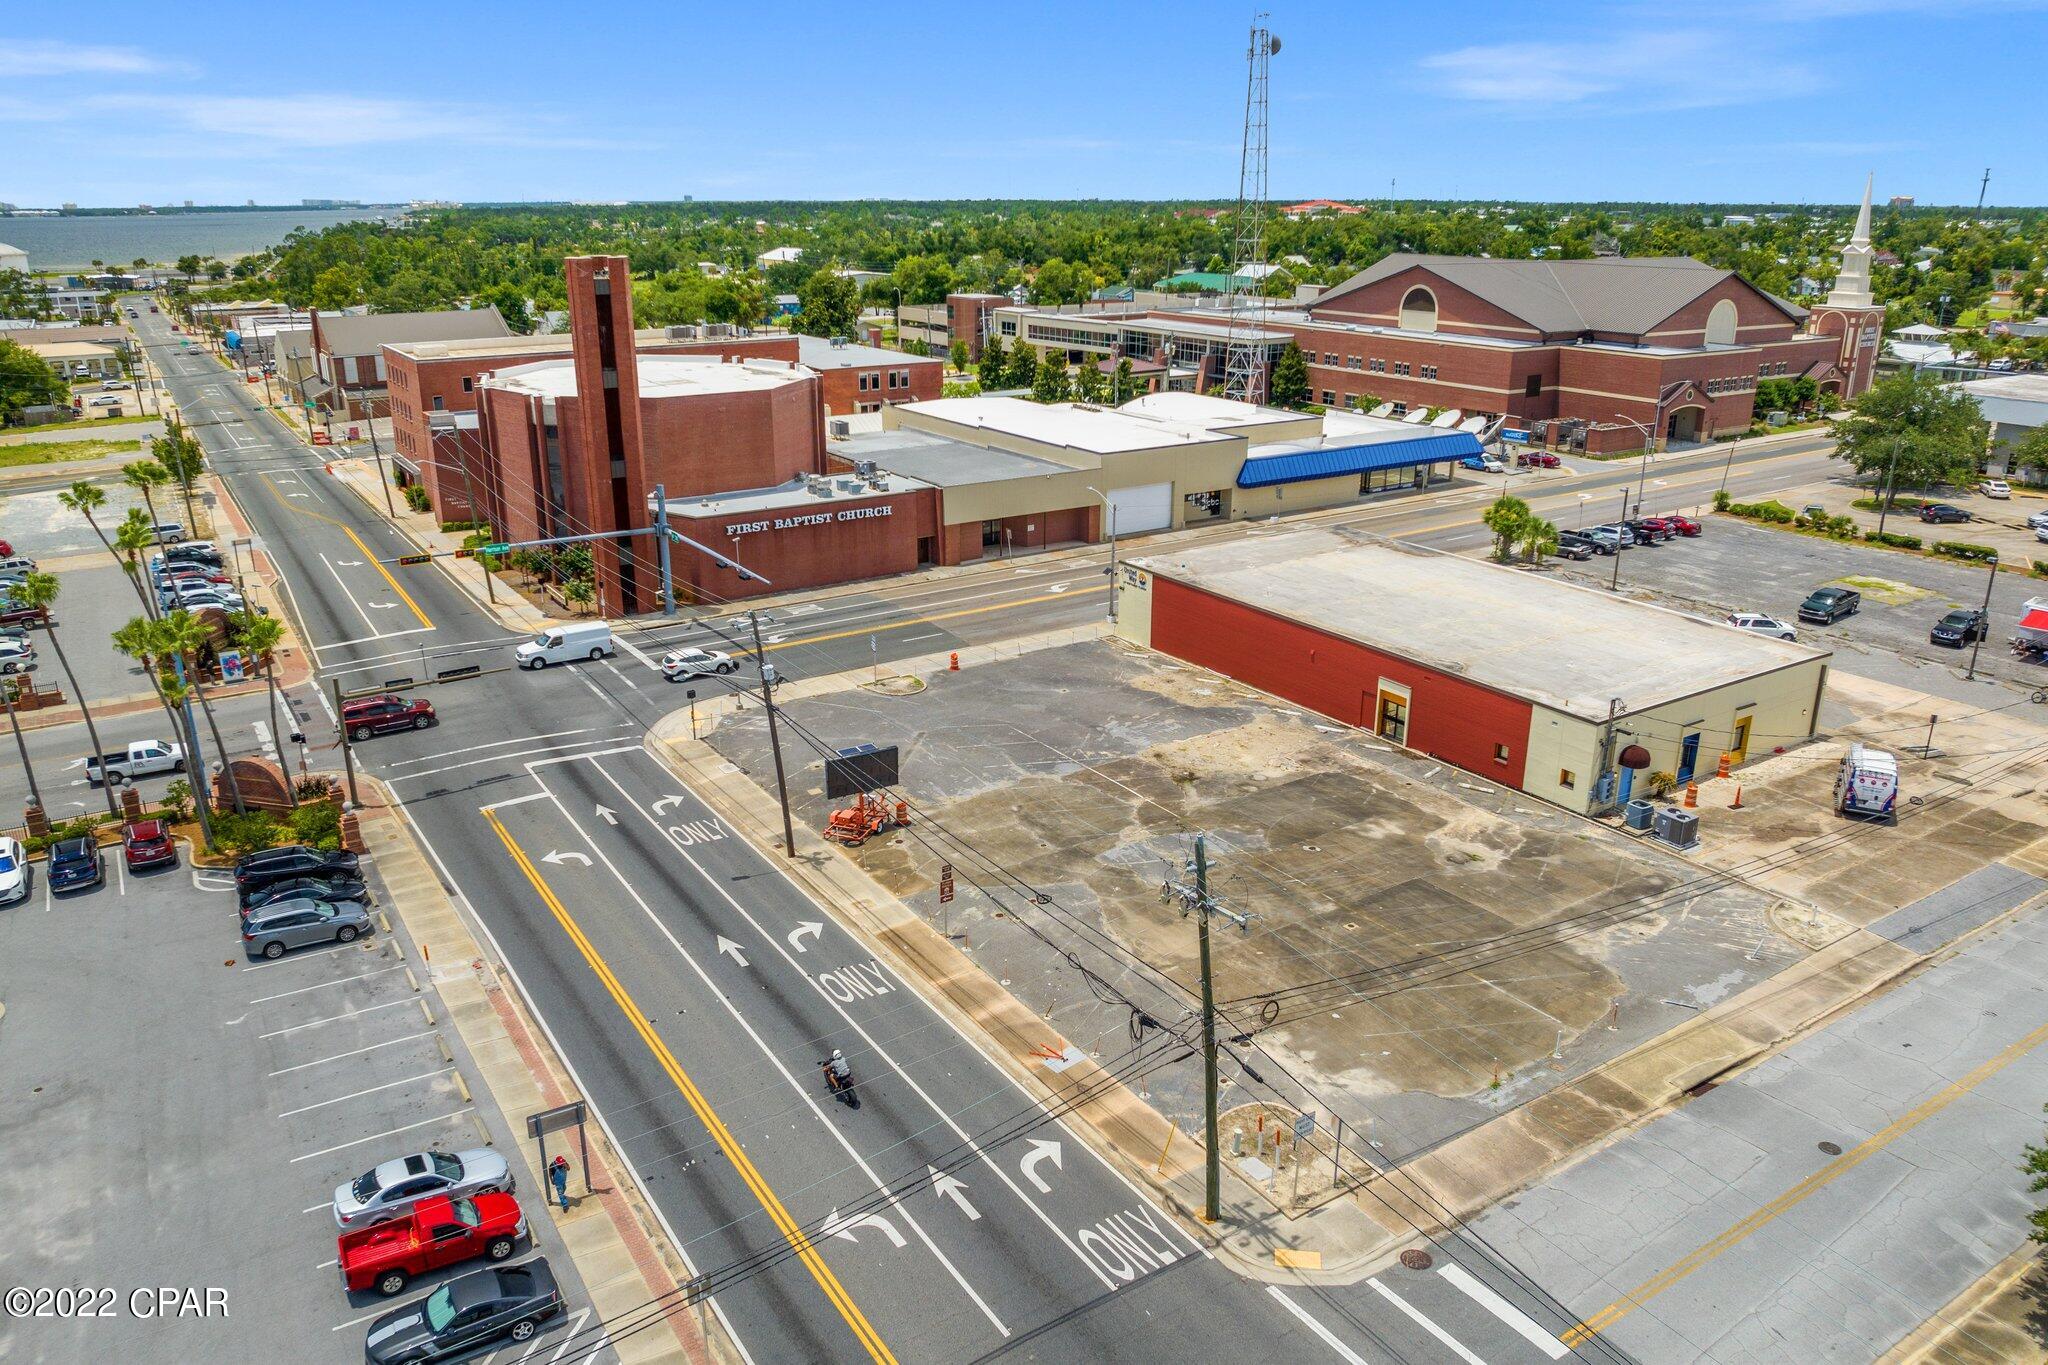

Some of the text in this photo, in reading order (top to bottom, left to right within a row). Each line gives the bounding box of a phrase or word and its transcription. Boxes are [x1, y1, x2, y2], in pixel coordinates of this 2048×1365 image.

[726, 505, 893, 535] FIRST BAPTIST CHURCH
[1123, 566, 1137, 577] United
[1129, 575, 1137, 585] Way
[669, 818, 729, 845] ONLY
[820, 960, 896, 1002] ONLY
[1078, 1204, 1186, 1280] ONLY
